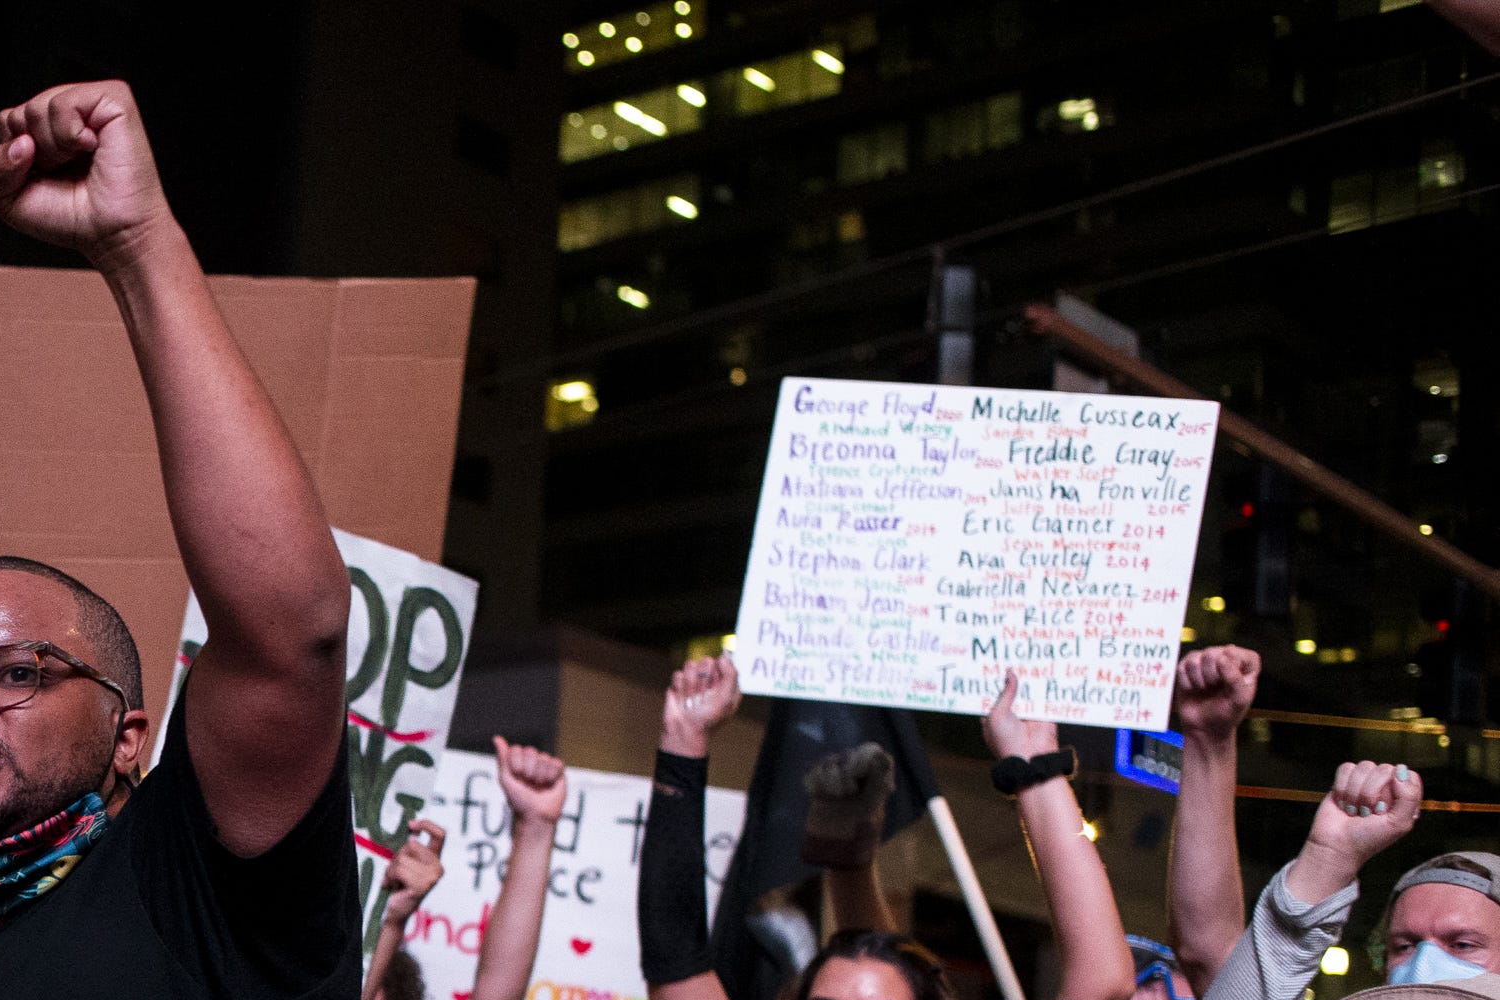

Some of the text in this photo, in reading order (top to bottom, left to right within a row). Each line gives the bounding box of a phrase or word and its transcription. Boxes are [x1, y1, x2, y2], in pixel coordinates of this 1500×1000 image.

[793, 385, 869, 424] George
[882, 391, 937, 427] Floyd
[971, 396, 1212, 436] Michelle Cusseax 2015
[788, 432, 897, 464] Breonna
[921, 436, 977, 477] Taylor
[1008, 437, 1096, 466] Freddie
[1114, 441, 1176, 481] Gray
[989, 475, 1192, 516] Janisha Fonville 2015
[962, 508, 1166, 539] Eric Garner 2014
[767, 540, 862, 576] Stephon
[873, 545, 931, 572] Clark
[957, 547, 1151, 583] Akai Gurley 2014
[763, 580, 849, 612] Botham
[858, 586, 906, 614] Jean
[936, 575, 1181, 604] Gabriella Nevarez 2014
[933, 602, 1128, 627] Tamir Rice 2014
[972, 635, 1173, 676] Michael Brown 2014
[935, 663, 1032, 697] Tanisa
[1045, 678, 1141, 707] Anderson
[1113, 708, 1152, 724] 2014
